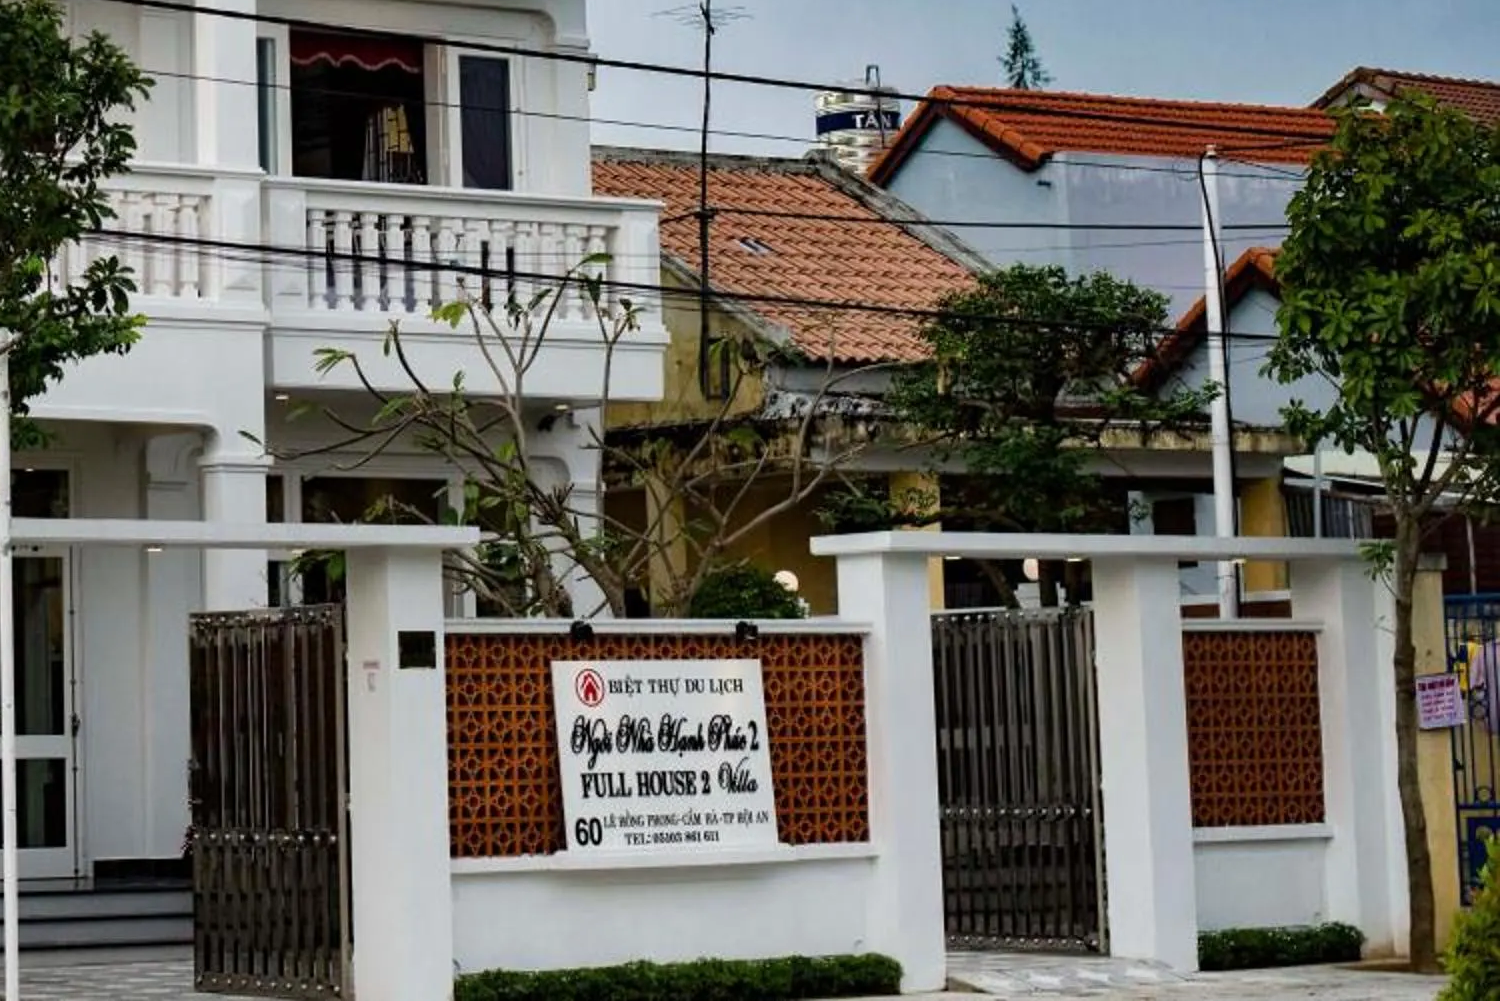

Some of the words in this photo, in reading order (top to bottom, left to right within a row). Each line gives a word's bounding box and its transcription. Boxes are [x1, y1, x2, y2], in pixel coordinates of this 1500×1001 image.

[852, 110, 892, 128] TÂN
[608, 674, 642, 697] BIỆT
[648, 677, 679, 698] THỰ
[685, 678, 705, 693] DU
[709, 678, 744, 696] LỊCH
[658, 713, 706, 758] Hạnh
[747, 720, 759, 751] 2
[580, 772, 632, 798] FULL
[636, 770, 697, 796] HOUSE
[701, 770, 711, 794] 2
[718, 756, 758, 794] Villa
[575, 817, 603, 846] 60
